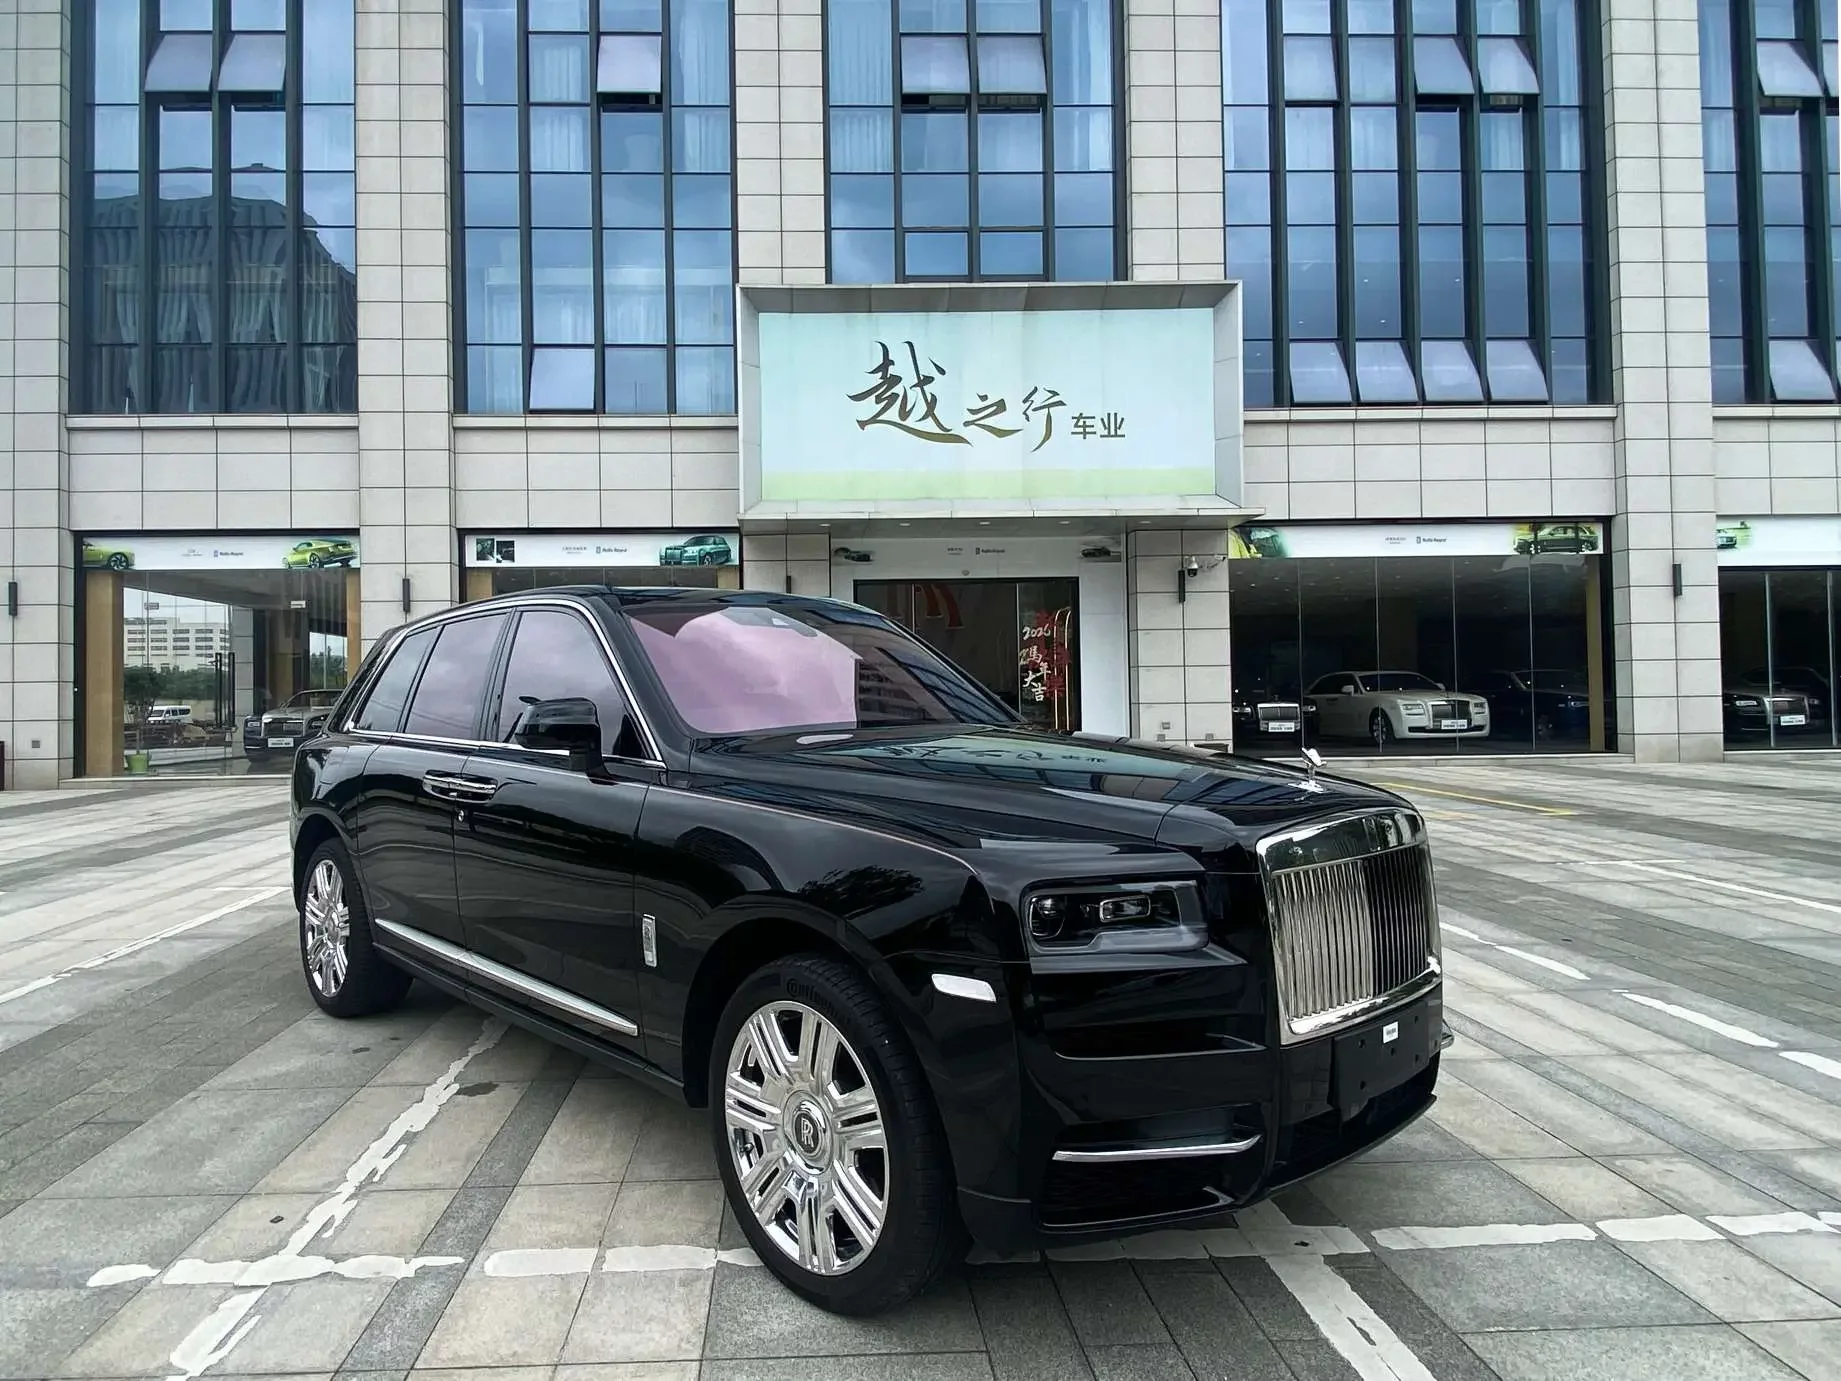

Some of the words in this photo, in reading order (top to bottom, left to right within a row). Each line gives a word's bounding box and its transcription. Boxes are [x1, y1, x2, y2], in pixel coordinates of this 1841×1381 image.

[845, 339, 1067, 454] 越之行
[1070, 412, 1126, 440] 车业
[1022, 623, 1051, 641] 2026
